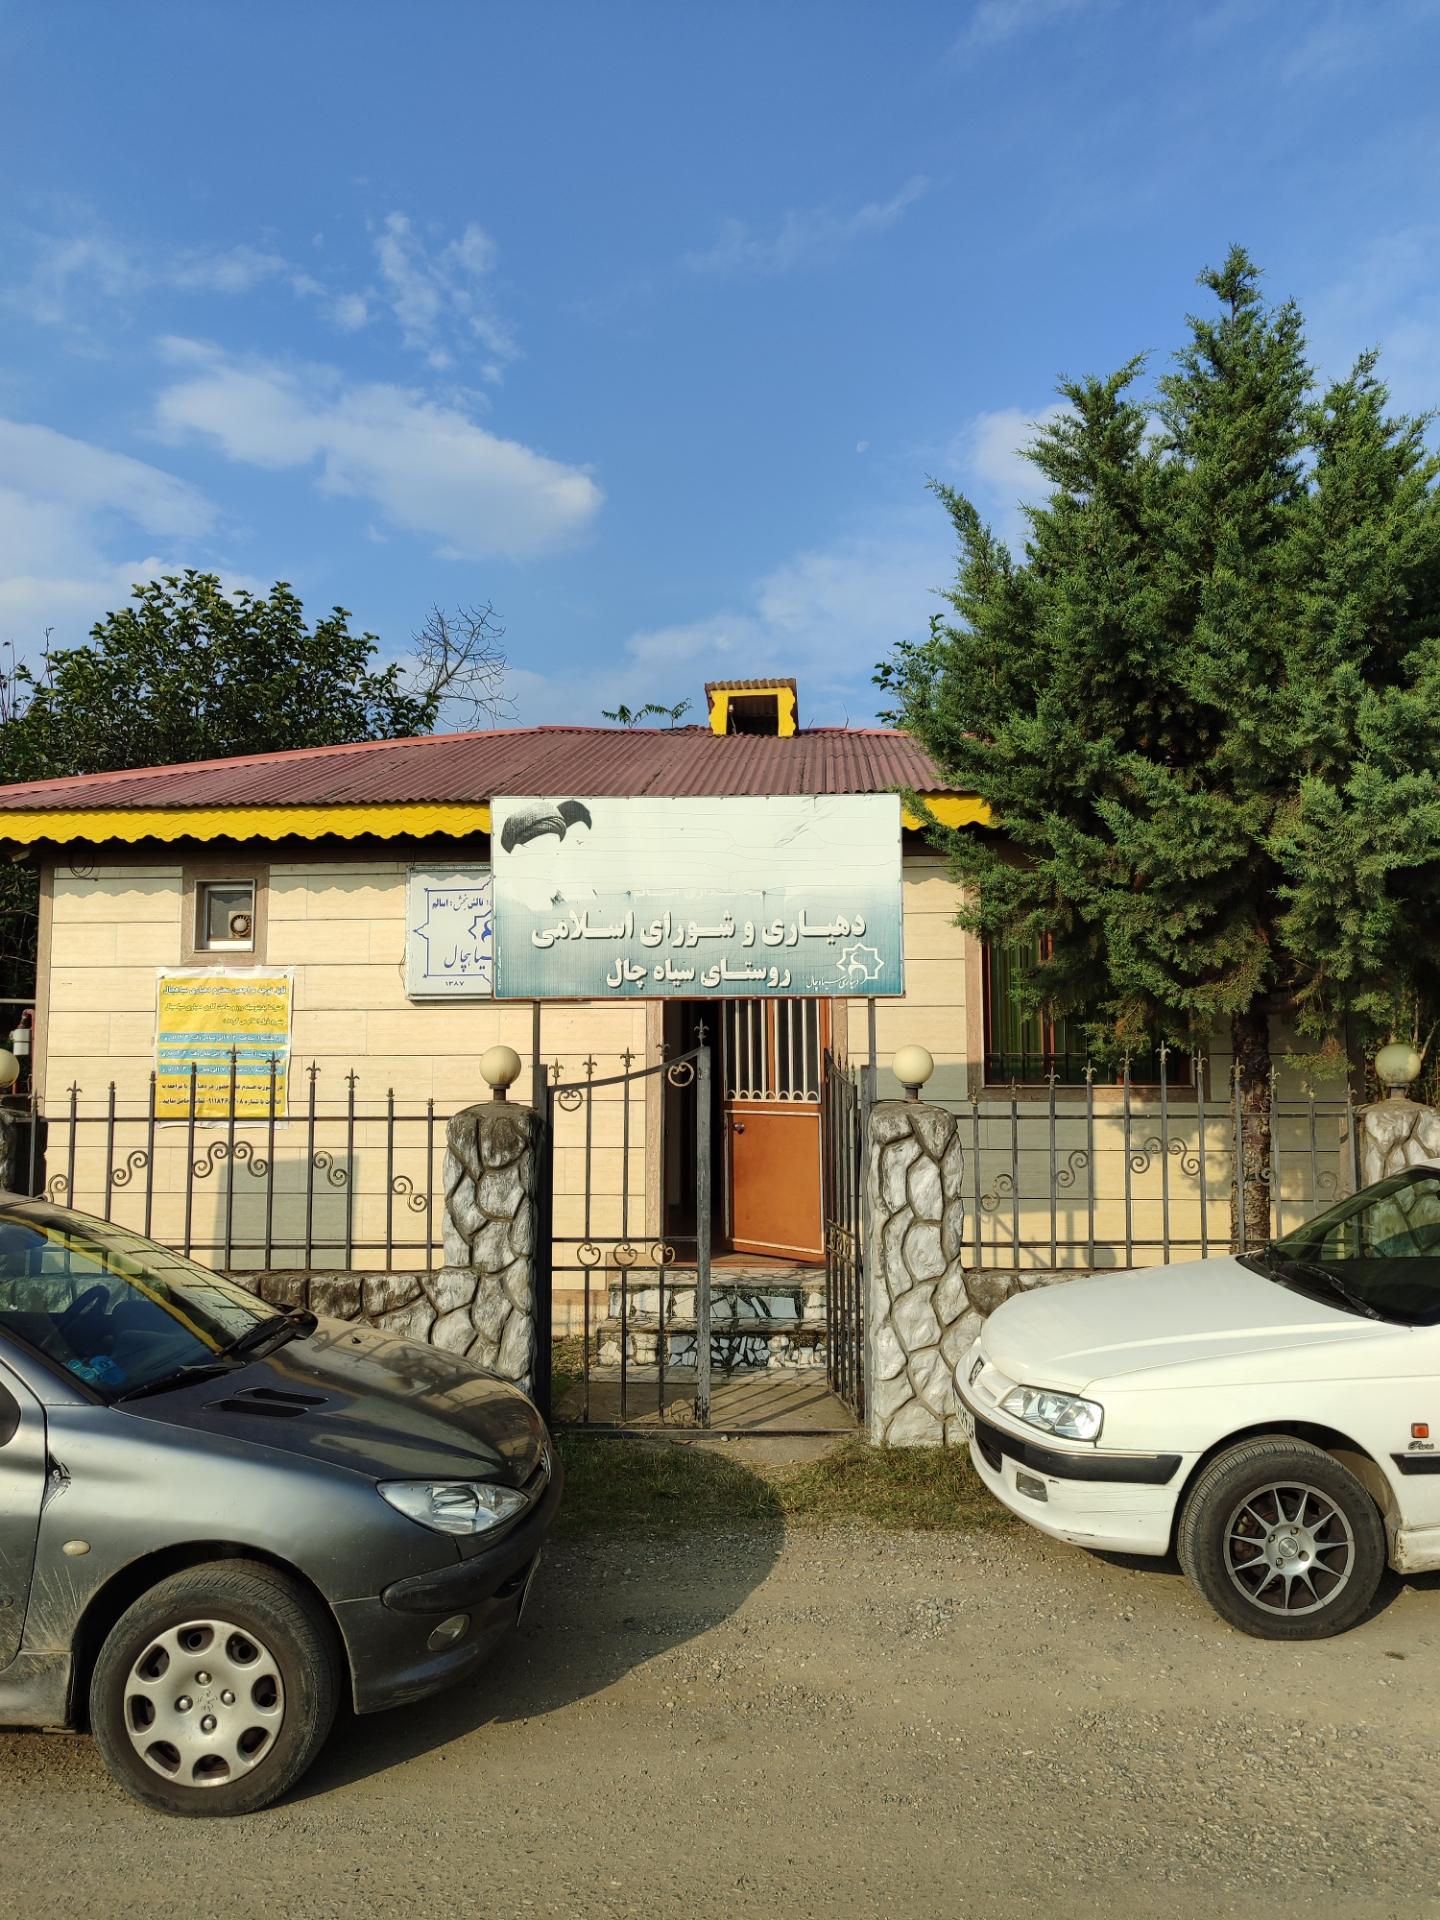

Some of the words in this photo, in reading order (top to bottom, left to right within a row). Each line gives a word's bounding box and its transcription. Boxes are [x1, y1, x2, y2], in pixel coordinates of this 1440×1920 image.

[531, 909, 635, 949] اسلامی
[639, 909, 736, 948] شورای
[742, 919, 756, 948] و
[762, 909, 867, 947] دهیاری
[606, 957, 649, 989] چال
[653, 957, 696, 987] سیاه
[700, 957, 792, 988] روستای
